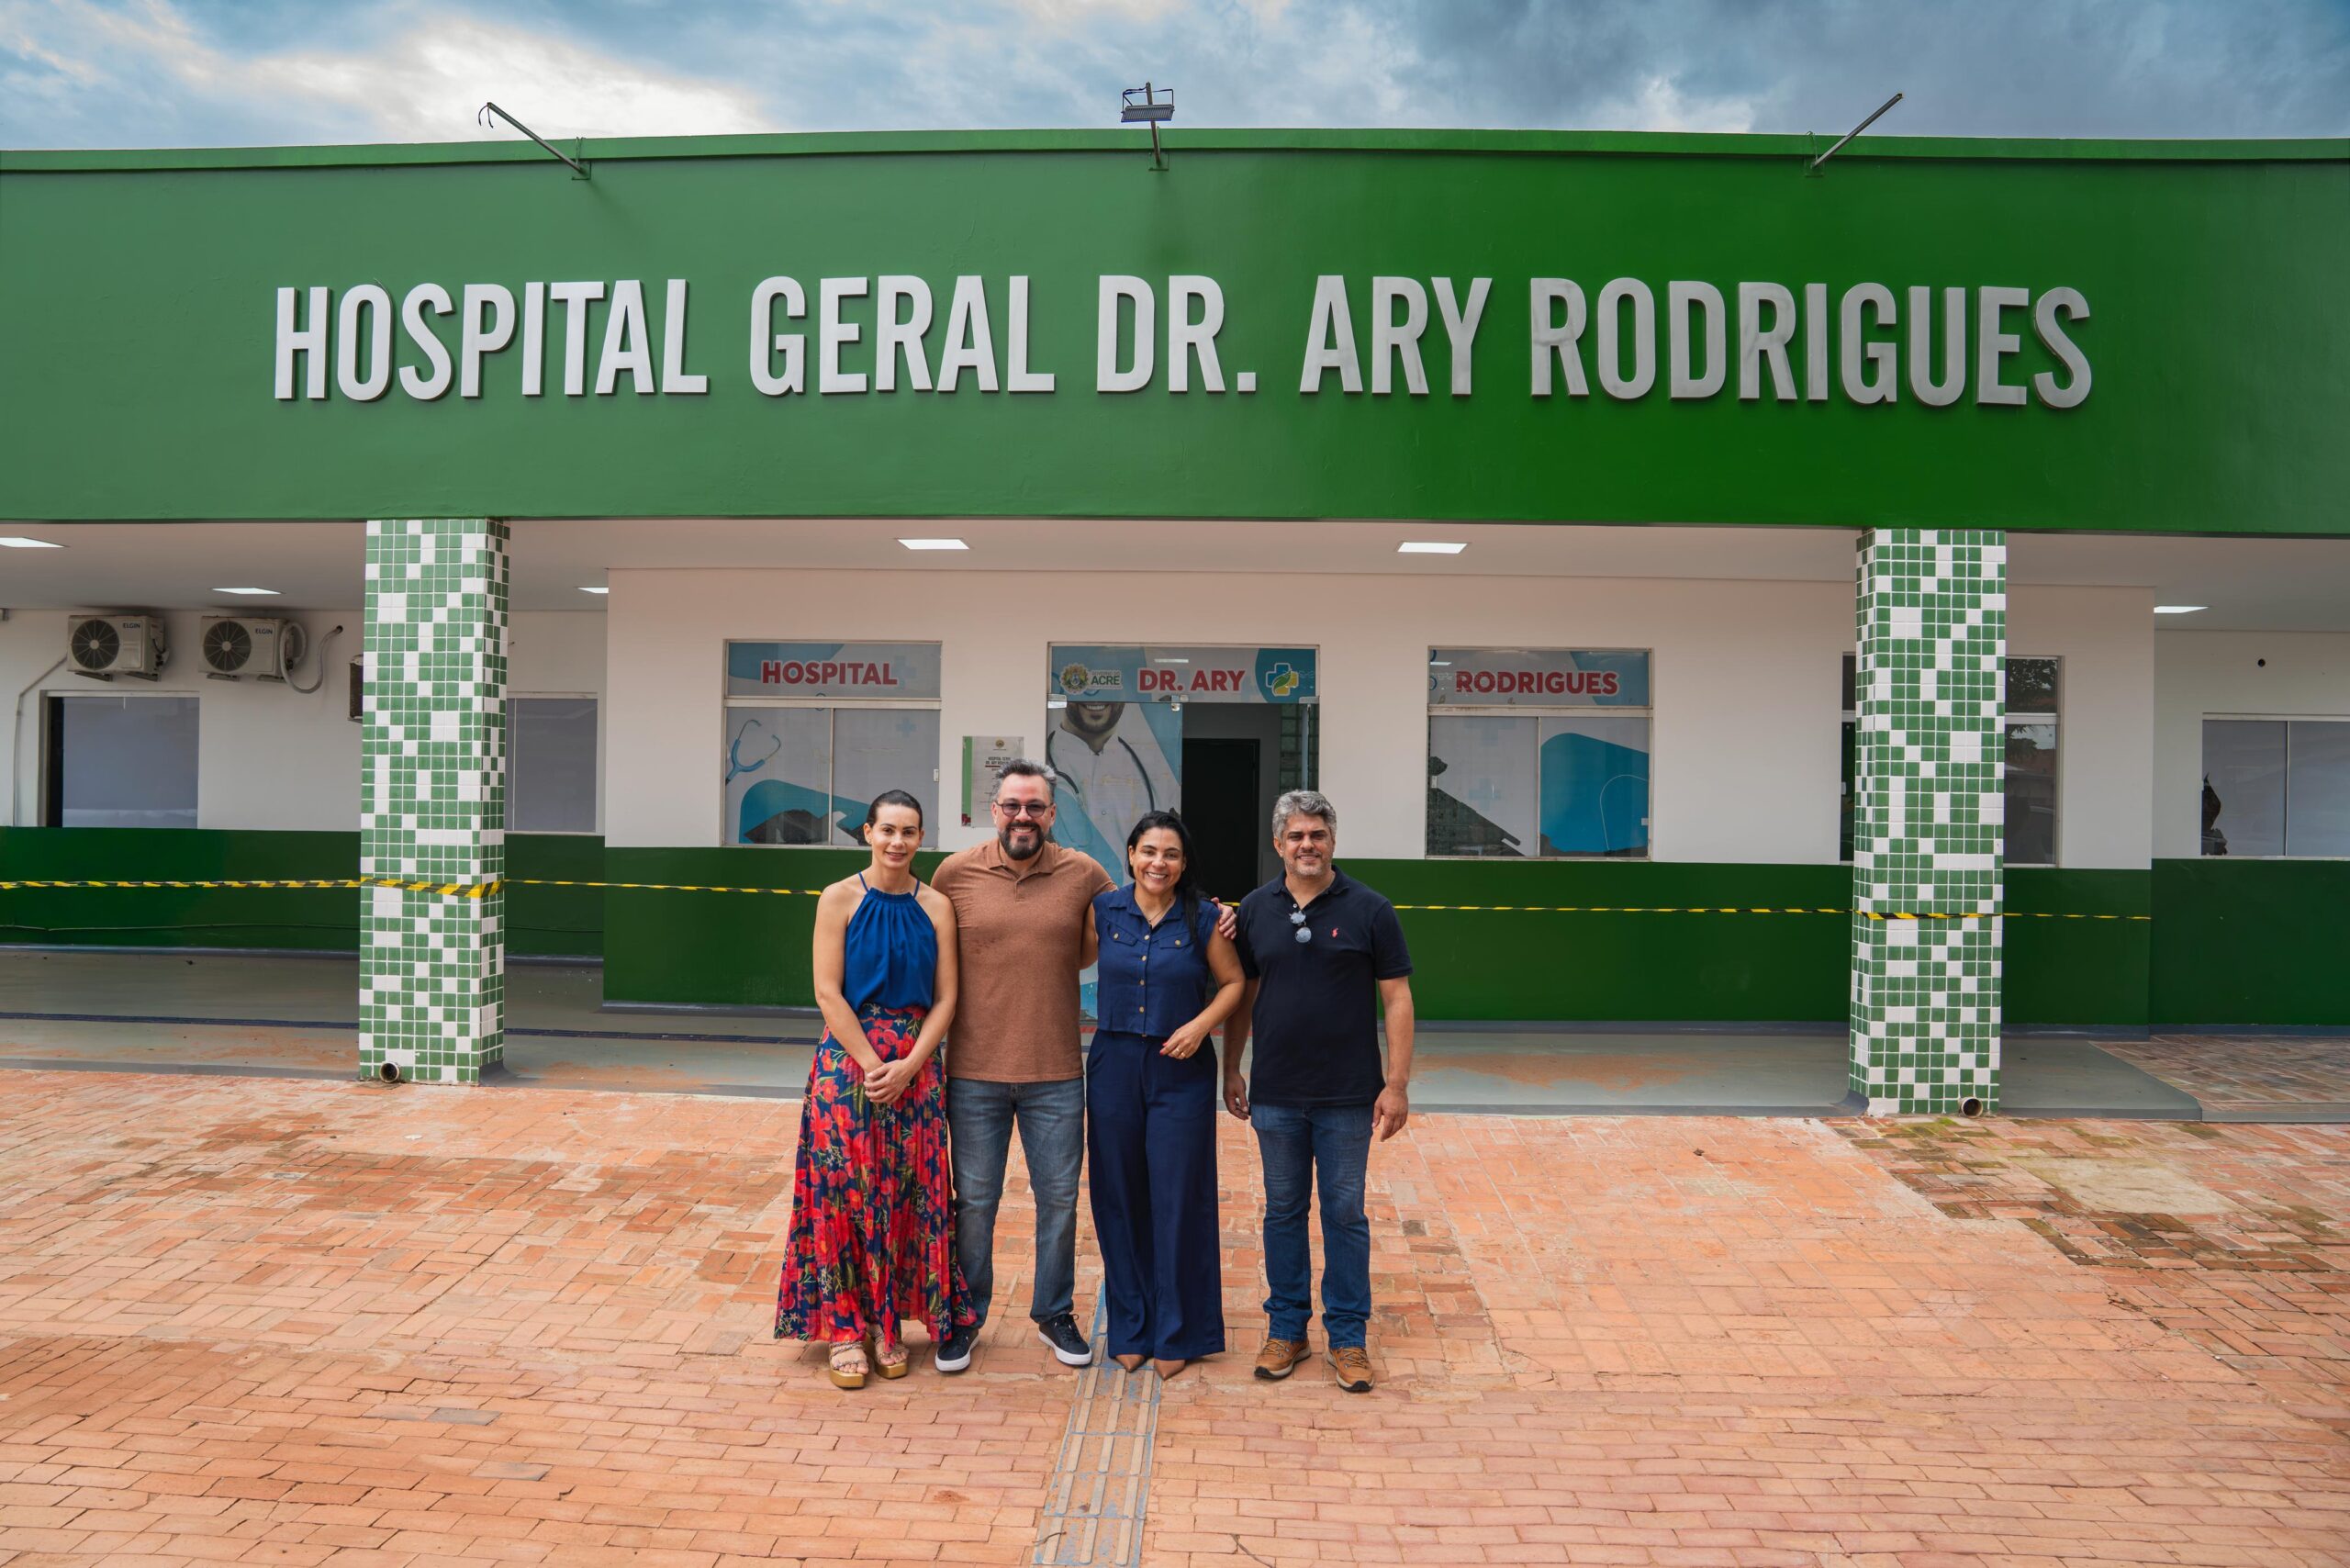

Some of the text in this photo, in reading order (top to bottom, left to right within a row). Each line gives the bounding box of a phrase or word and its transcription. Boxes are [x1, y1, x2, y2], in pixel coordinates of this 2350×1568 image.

[274, 274, 2092, 409] HOSPITAL GERAL DR. ARY RODRIGUES
[762, 661, 898, 685] HOSPITAL
[1091, 676, 1120, 685] ACRE
[1139, 669, 1246, 691] DR. ARY
[1456, 671, 1617, 694] RODRIGUES
